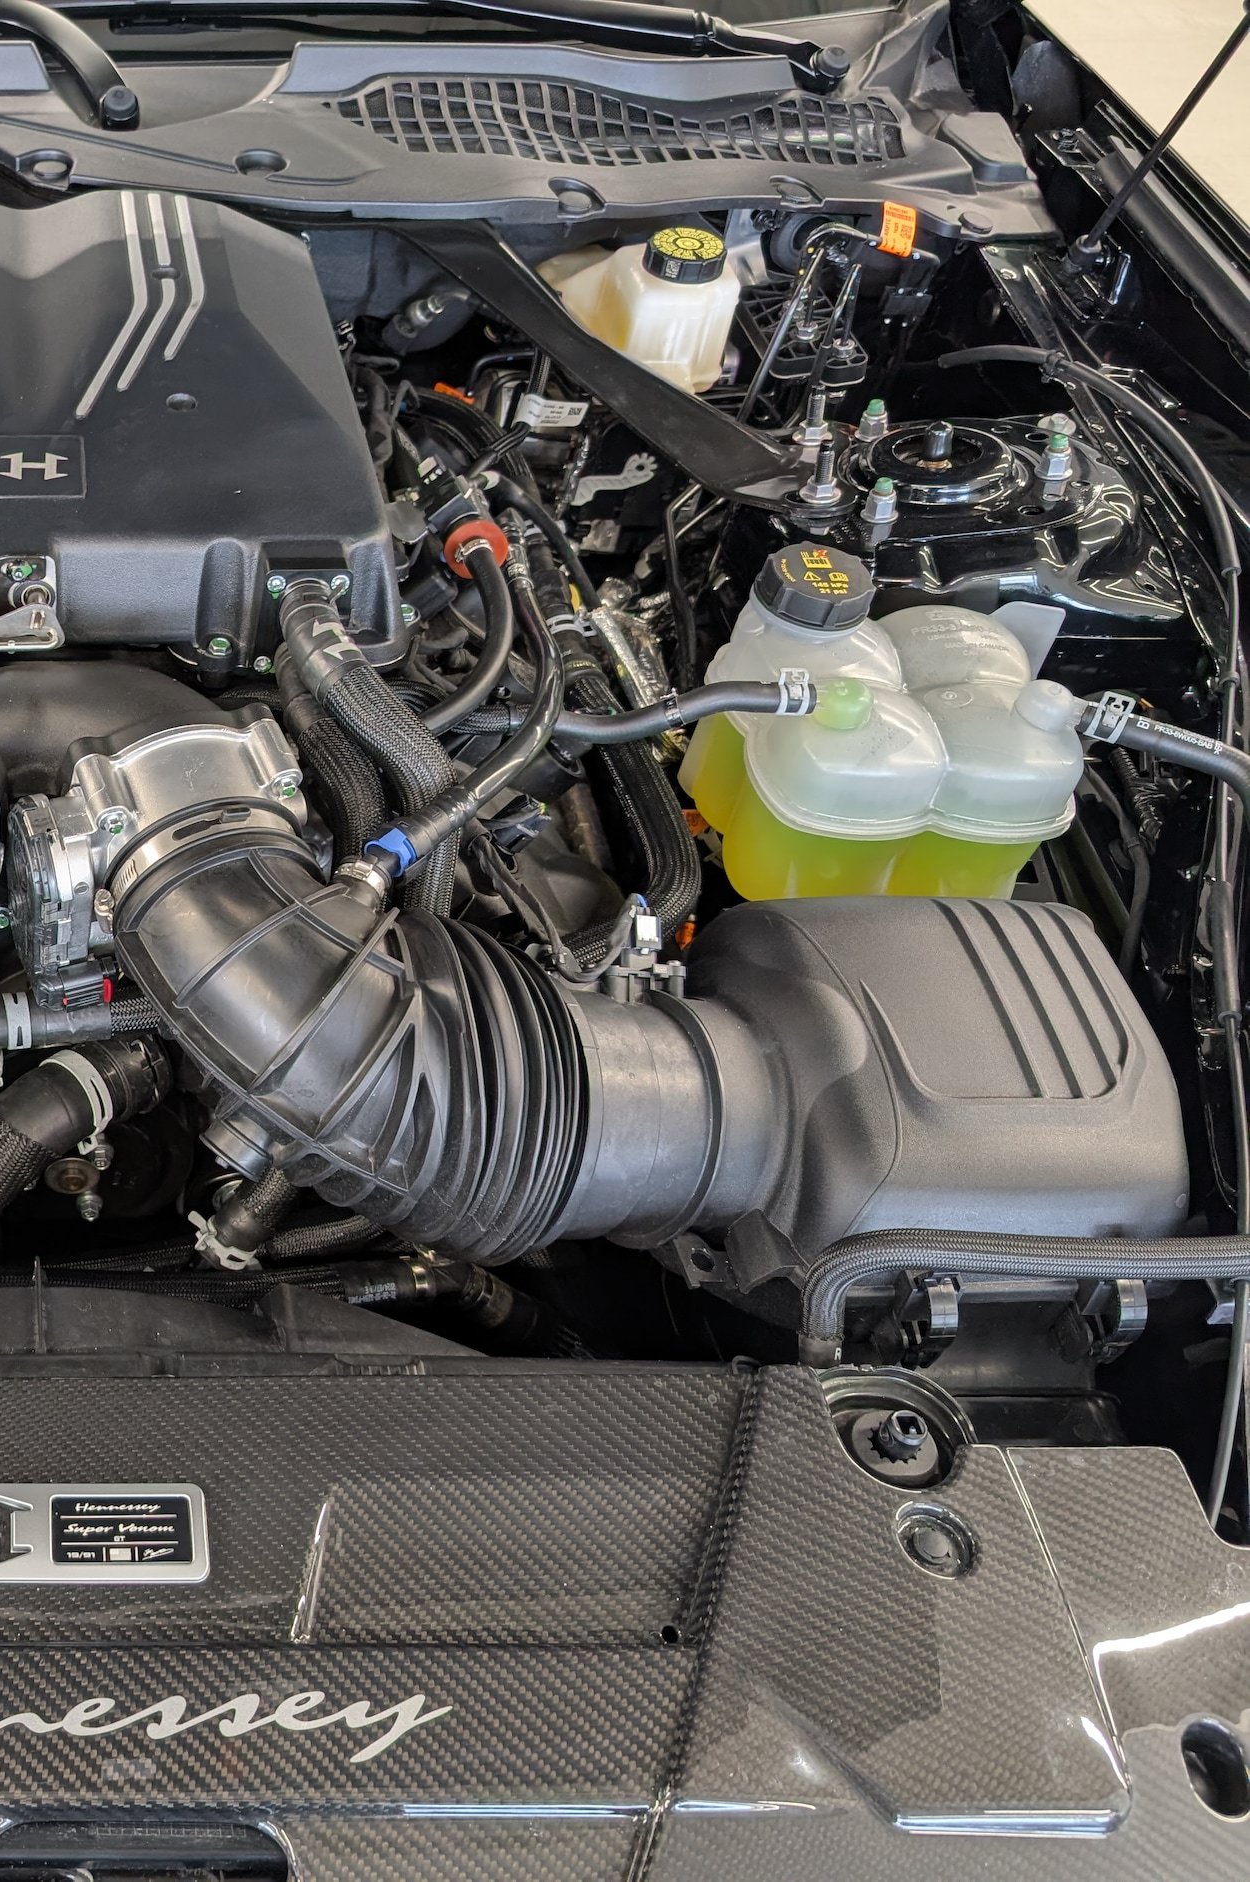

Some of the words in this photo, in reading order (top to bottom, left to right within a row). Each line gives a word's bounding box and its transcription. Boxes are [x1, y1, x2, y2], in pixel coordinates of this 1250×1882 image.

[75, 1502, 161, 1513] Hennessey
[63, 1523, 114, 1537] Super
[118, 1523, 175, 1533] Venom
